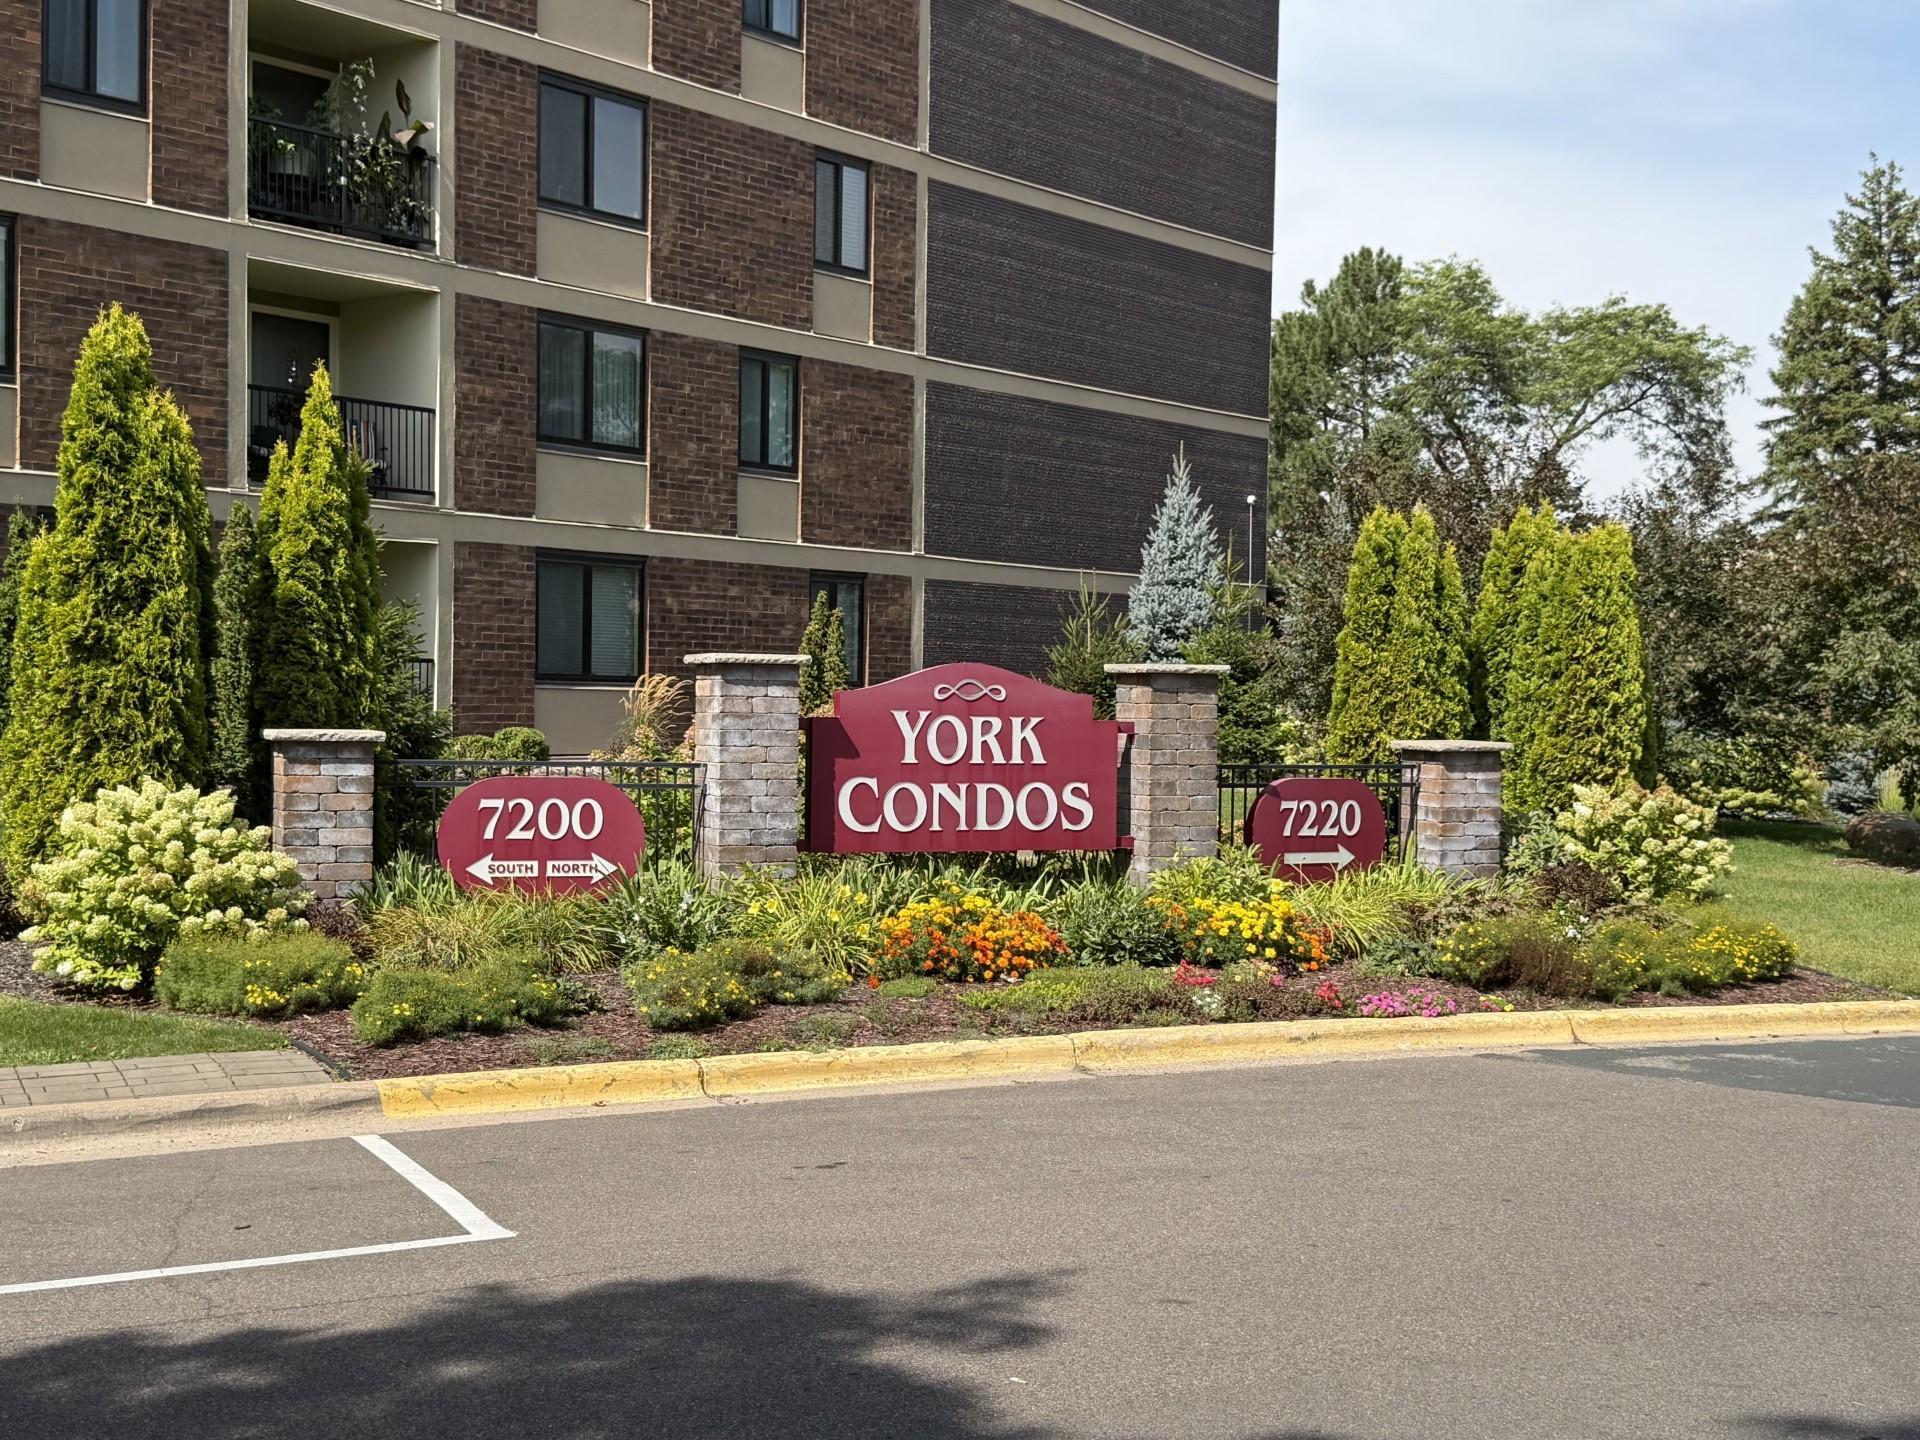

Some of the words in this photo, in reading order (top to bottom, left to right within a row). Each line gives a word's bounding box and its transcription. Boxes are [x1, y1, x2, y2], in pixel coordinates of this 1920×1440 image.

[890, 710, 1047, 764] YORK
[477, 798, 603, 840] 7200
[838, 776, 1094, 832] CONDOS
[1279, 799, 1362, 837] 7220
[488, 863, 534, 874] SOUTH
[551, 863, 598, 874] NORTH
